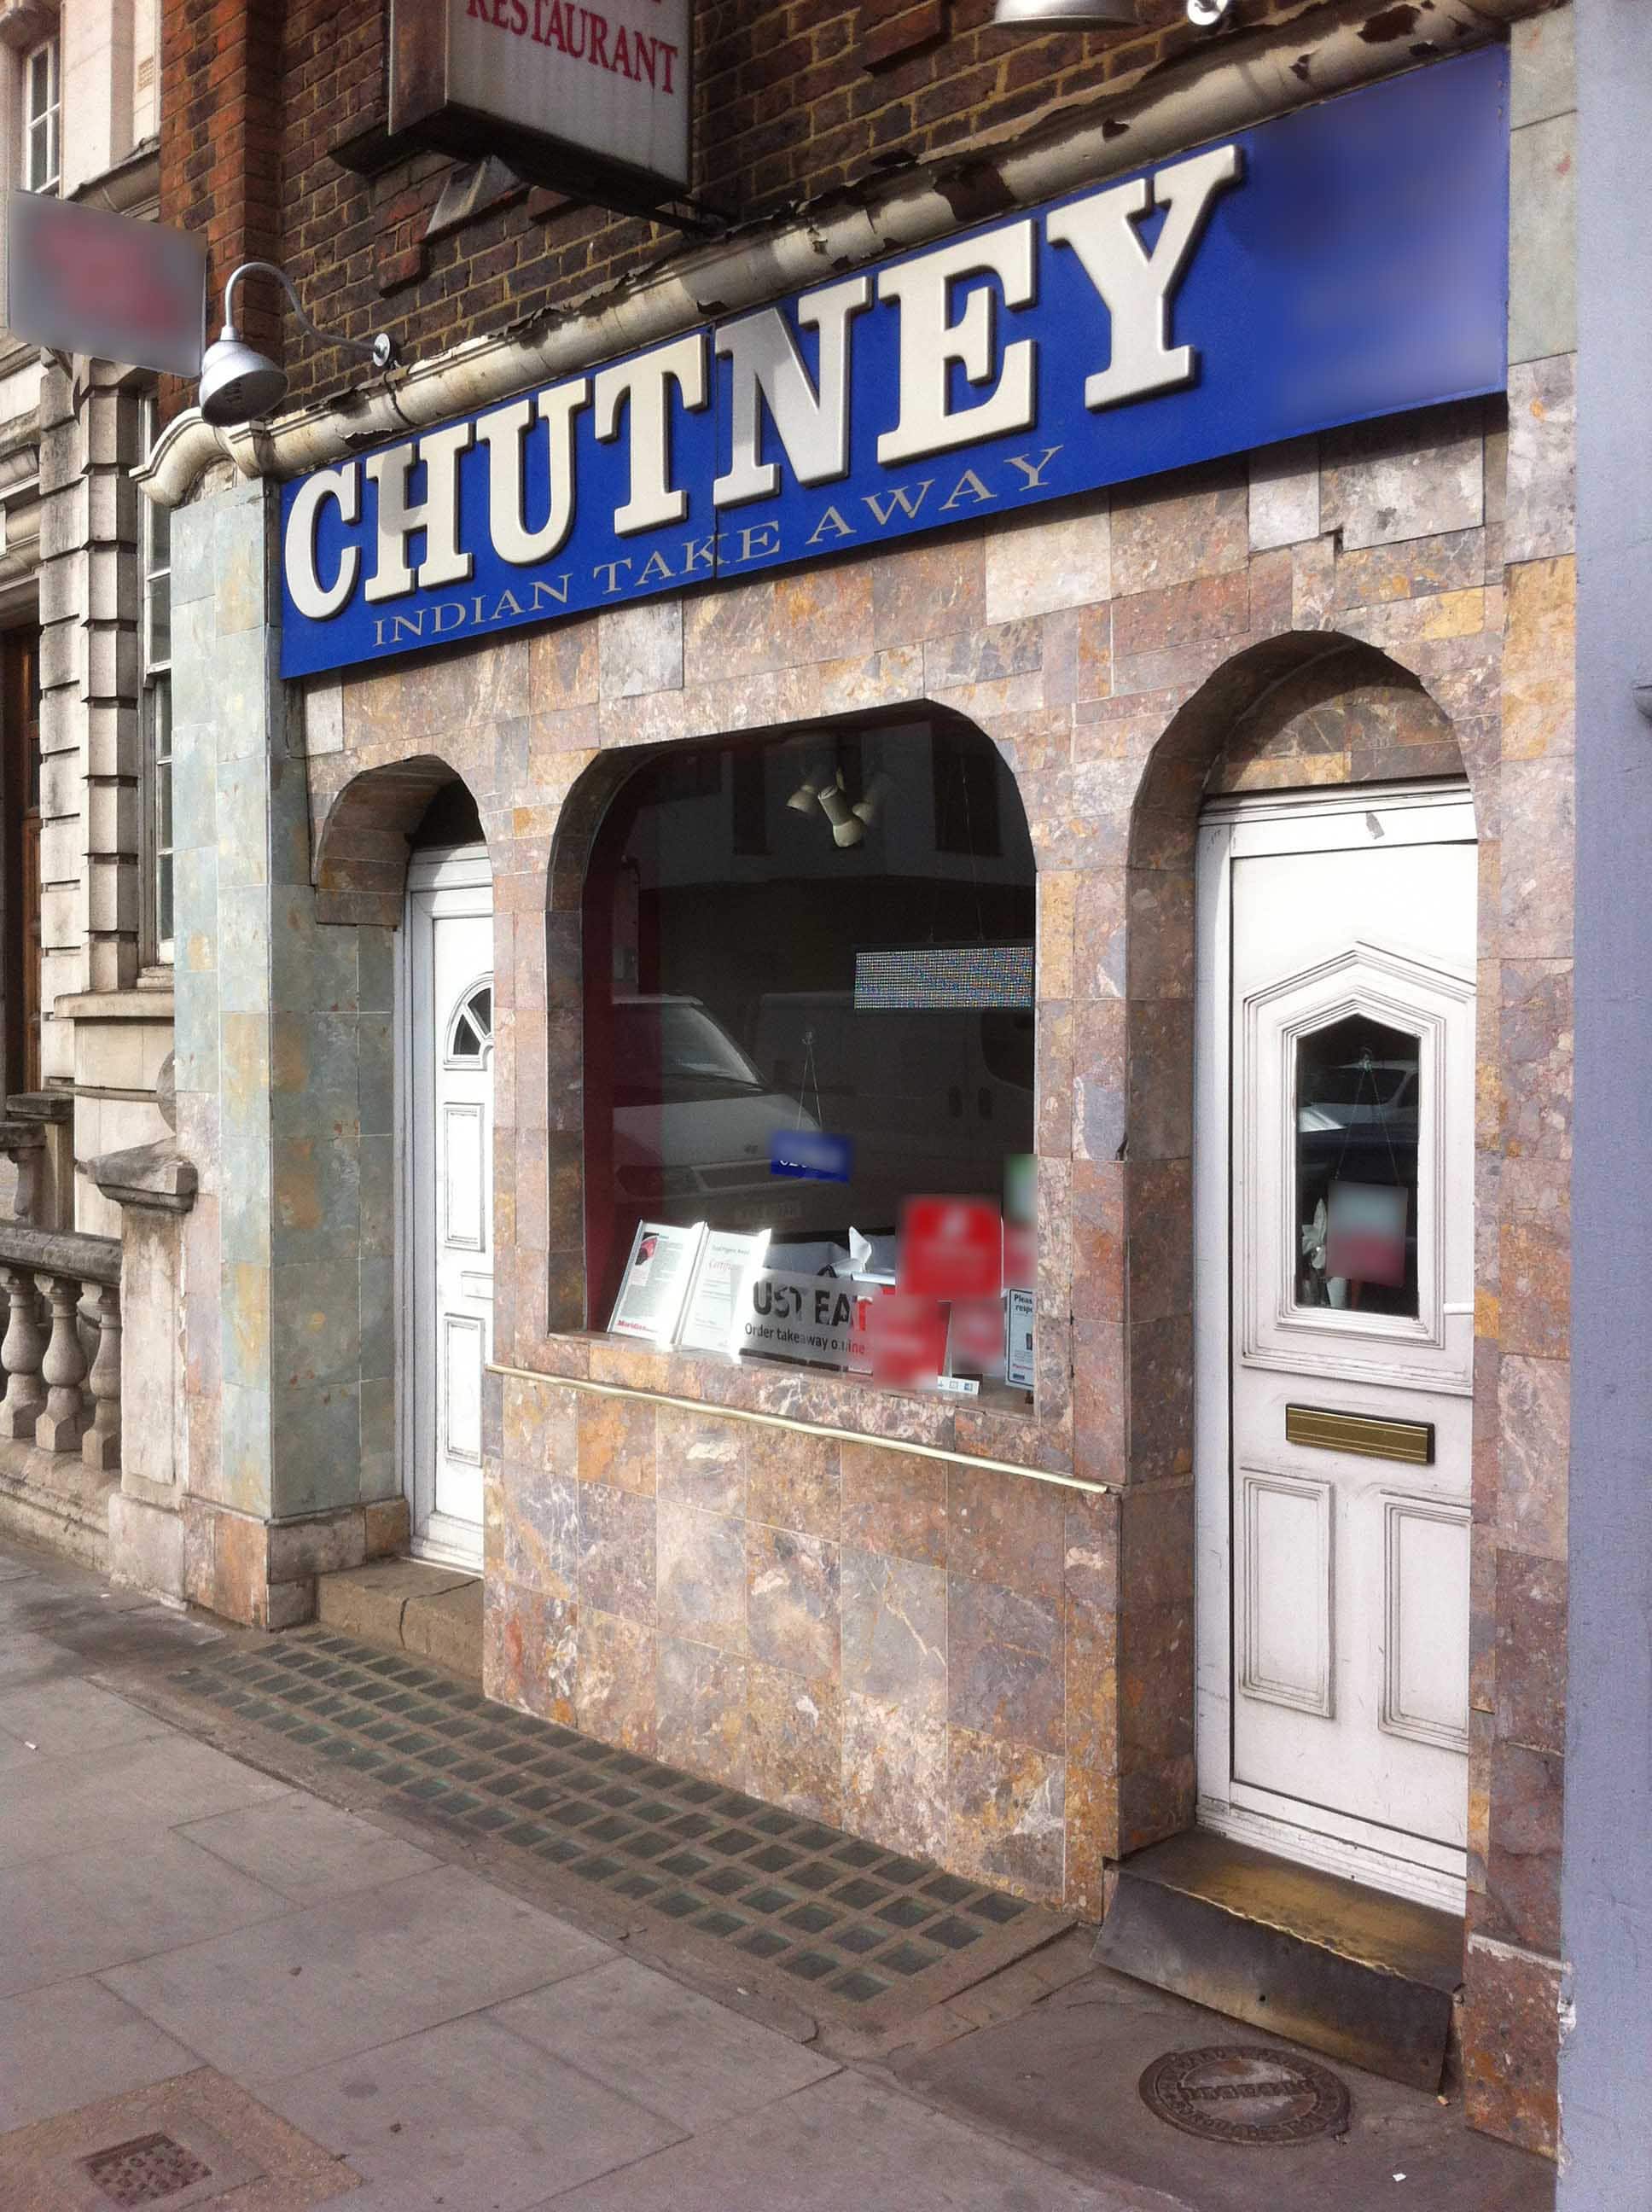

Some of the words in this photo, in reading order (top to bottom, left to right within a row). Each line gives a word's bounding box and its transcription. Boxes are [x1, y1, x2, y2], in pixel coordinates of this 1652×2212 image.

[284, 143, 1242, 622] CHUTNEY
[373, 573, 573, 647] INDIAN
[593, 520, 781, 595] TAKE
[805, 445, 1064, 544] AWAY
[745, 1323, 774, 1339] Order
[777, 1327, 828, 1352] takeaway
